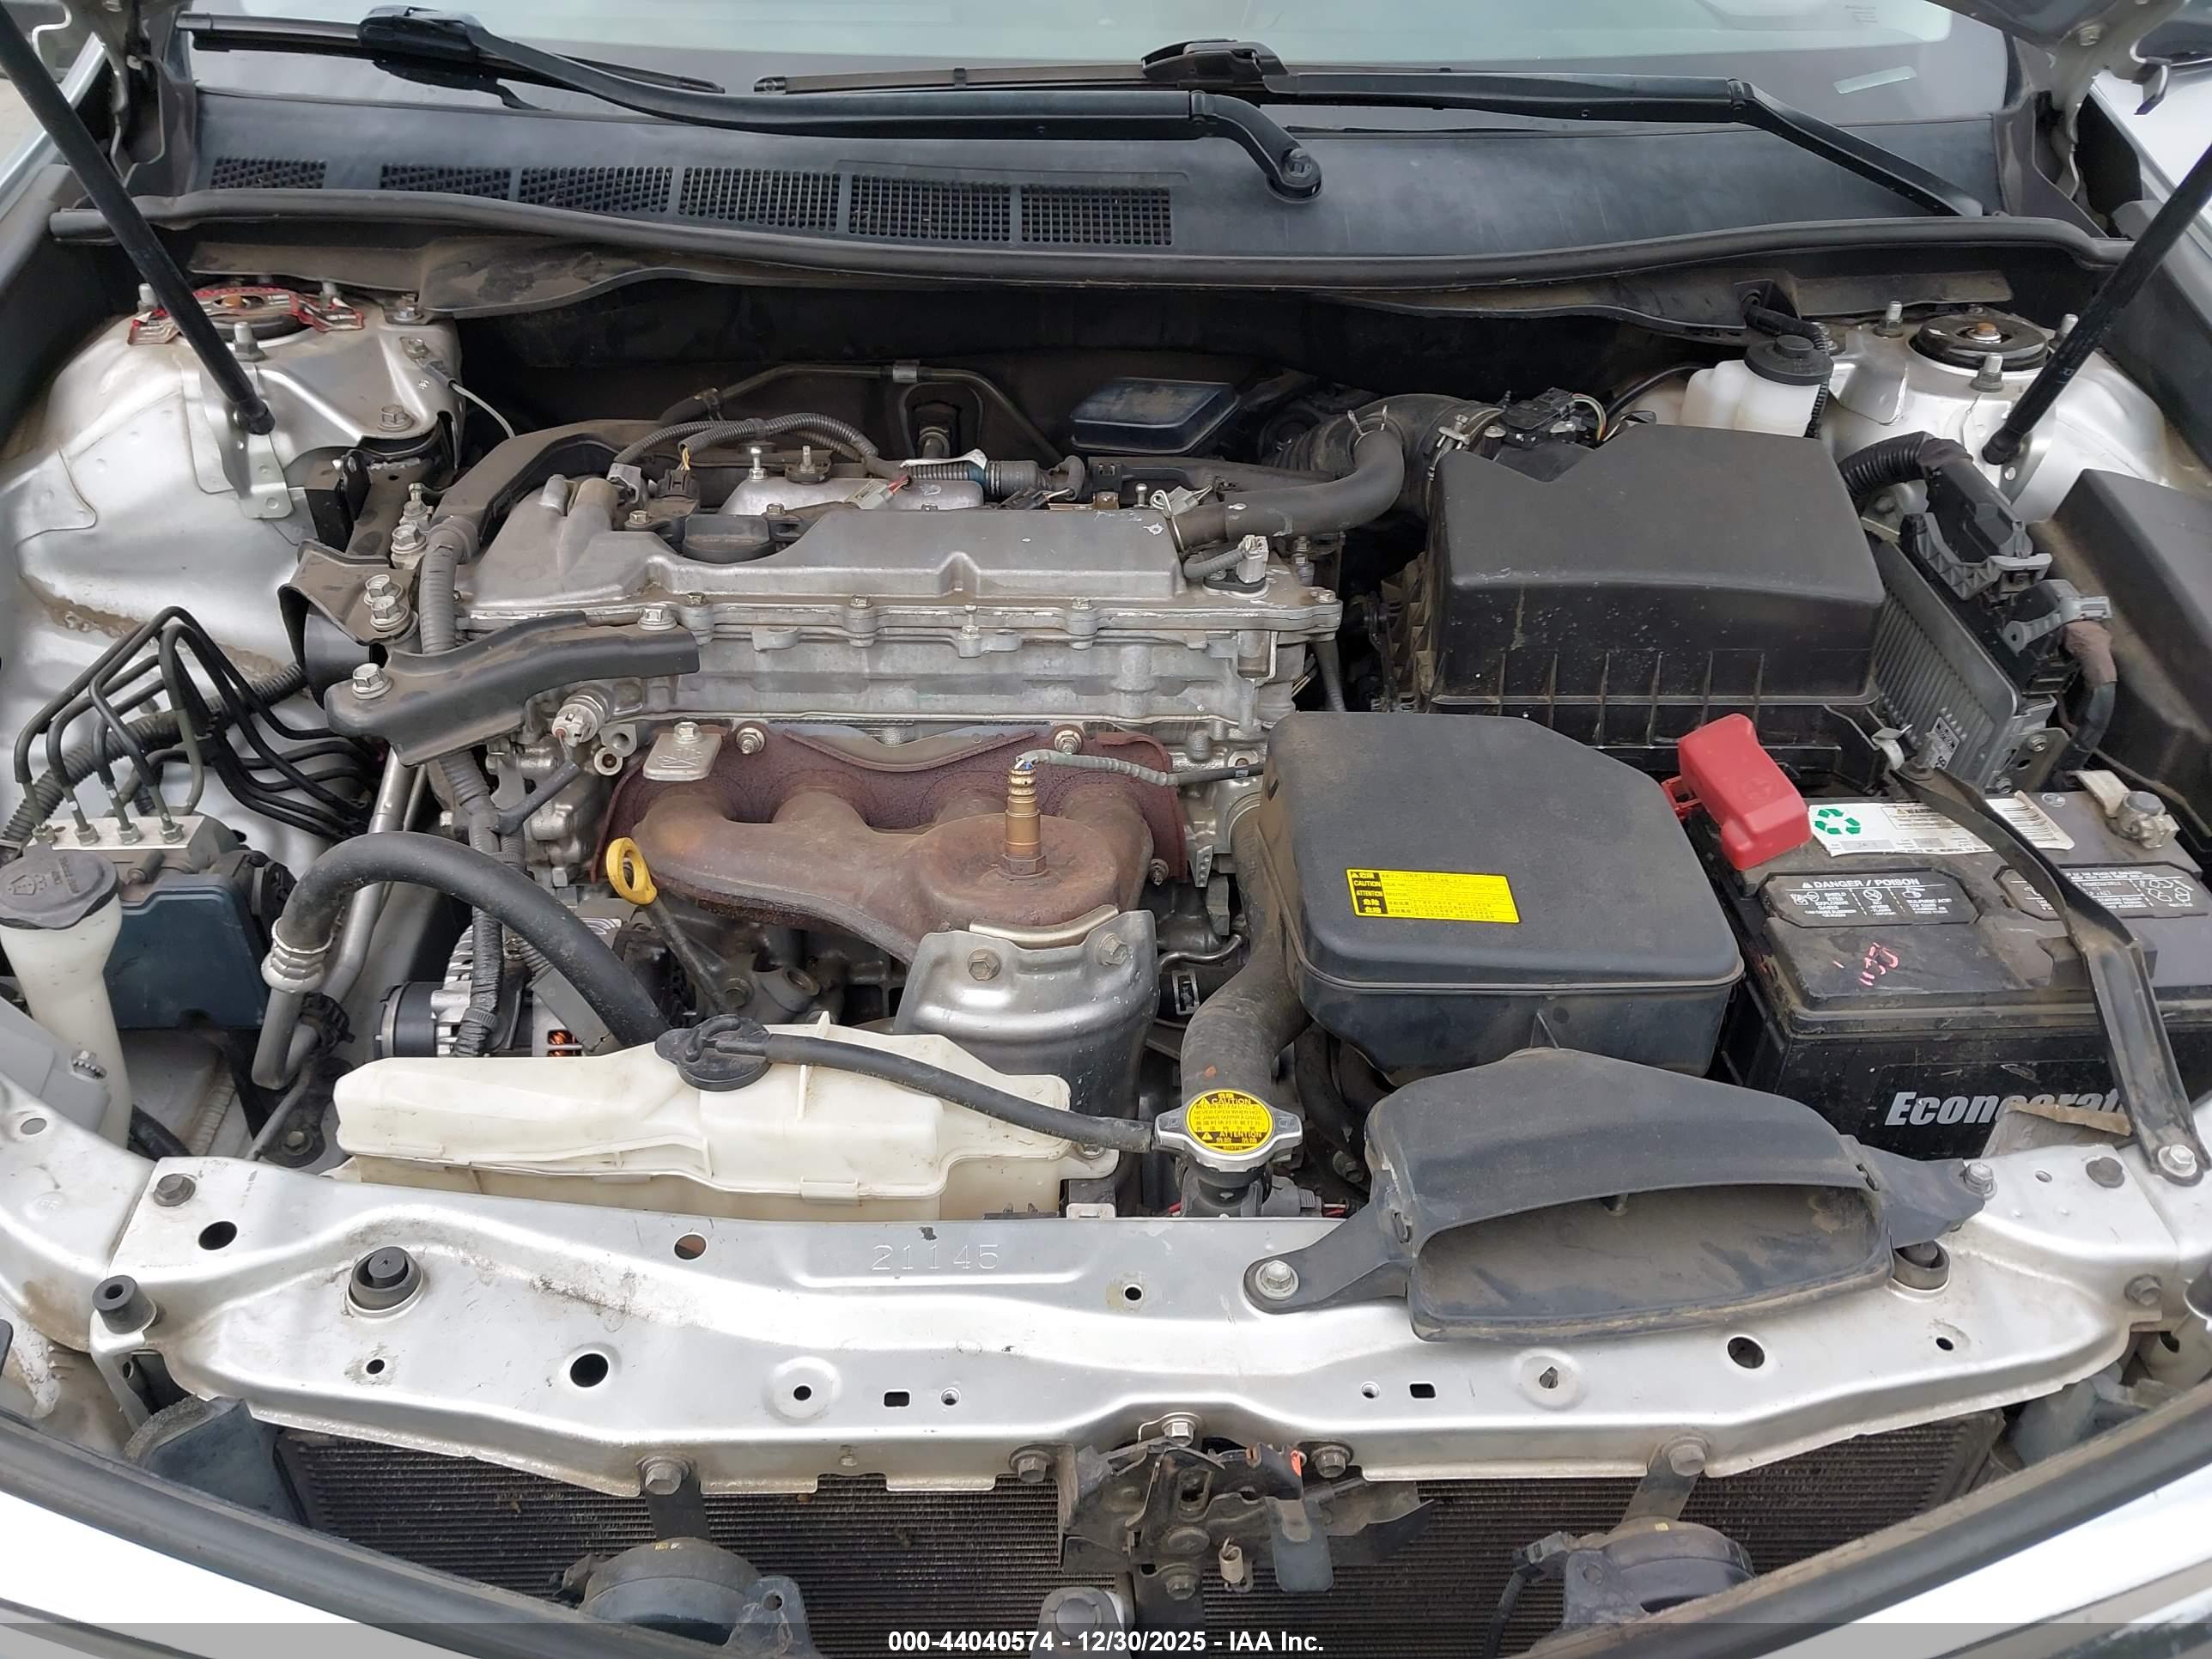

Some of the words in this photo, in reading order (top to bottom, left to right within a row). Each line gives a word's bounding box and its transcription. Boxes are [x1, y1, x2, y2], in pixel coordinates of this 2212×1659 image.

[1813, 879, 1865, 888] DANGER
[1874, 878, 1920, 887] POISON
[871, 1244, 999, 1271] 21145
